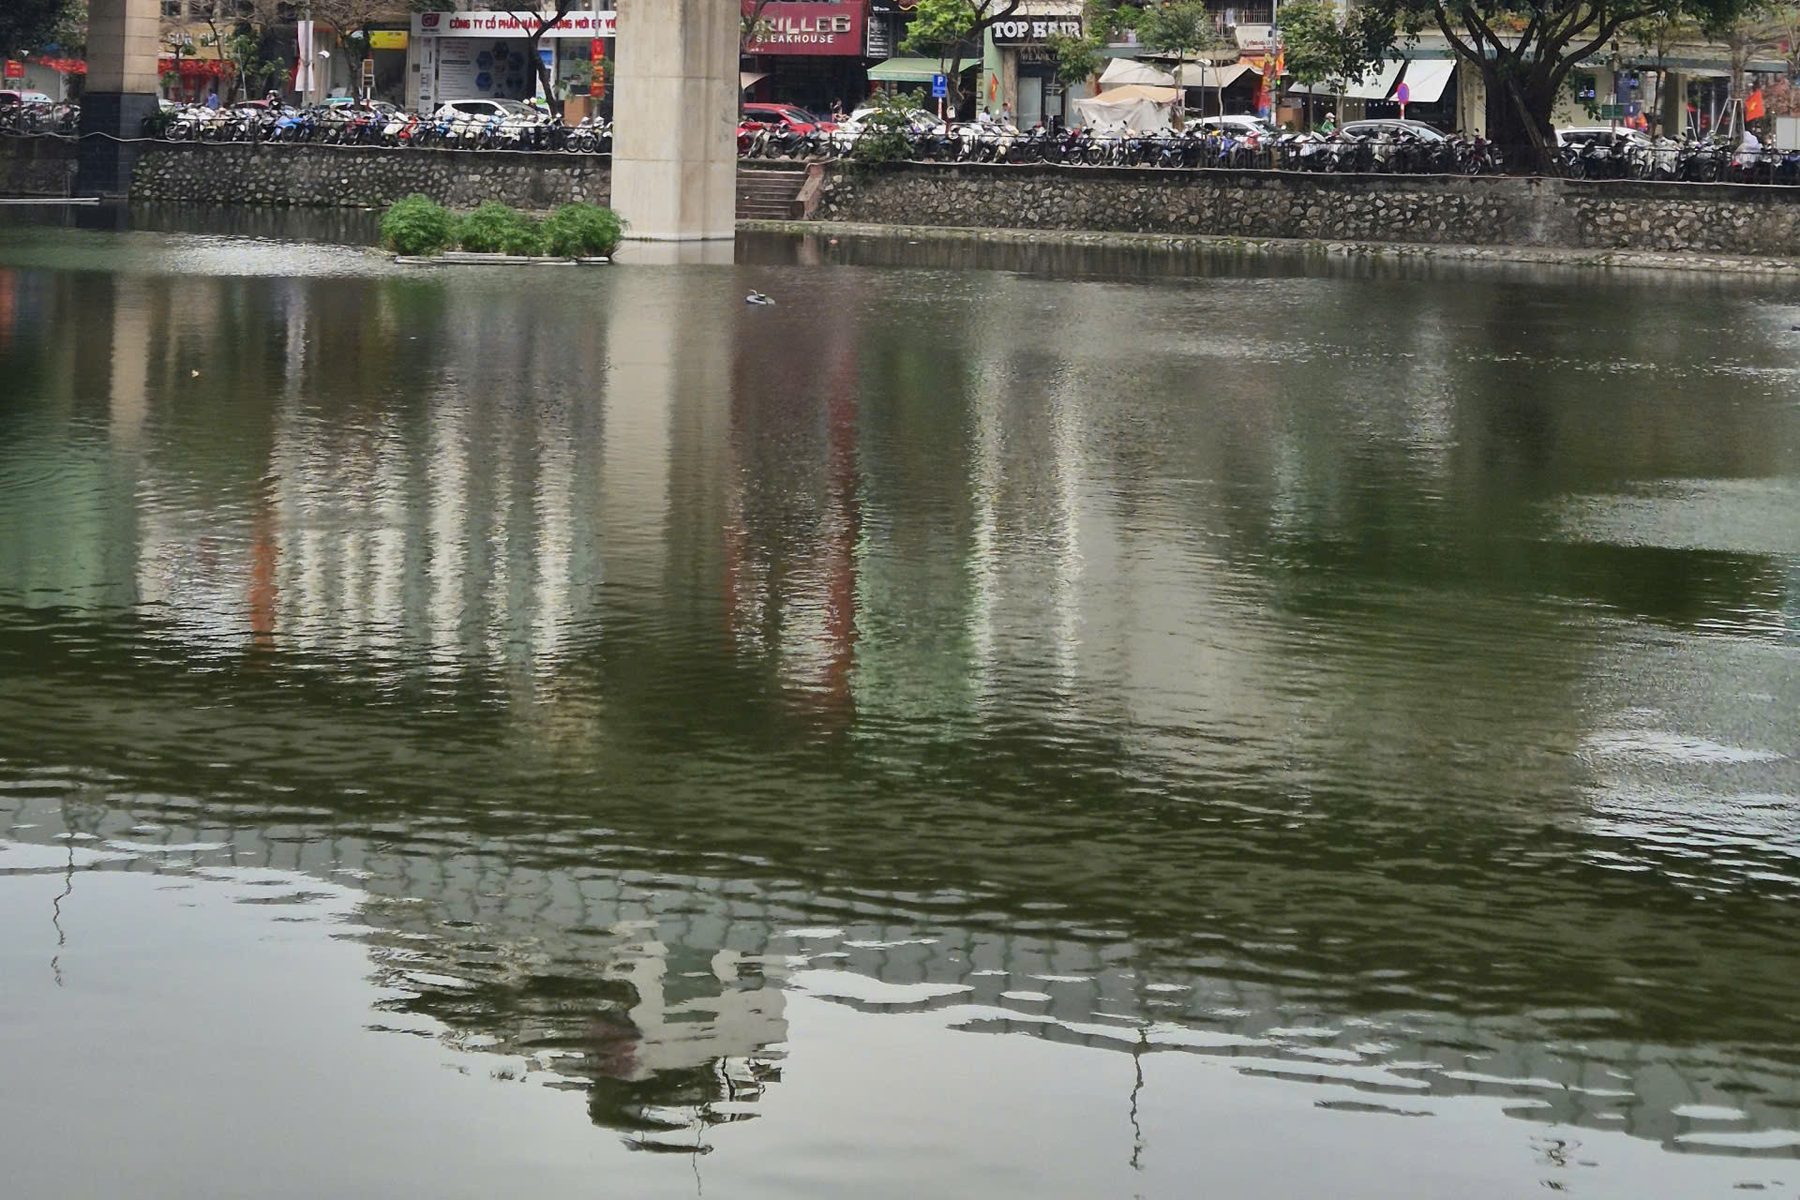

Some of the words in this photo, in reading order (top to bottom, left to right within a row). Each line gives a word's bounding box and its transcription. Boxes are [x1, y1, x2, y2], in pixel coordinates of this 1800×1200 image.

[474, 19, 484, 29] TY
[992, 21, 1030, 39] TOP
[937, 76, 944, 86] P
